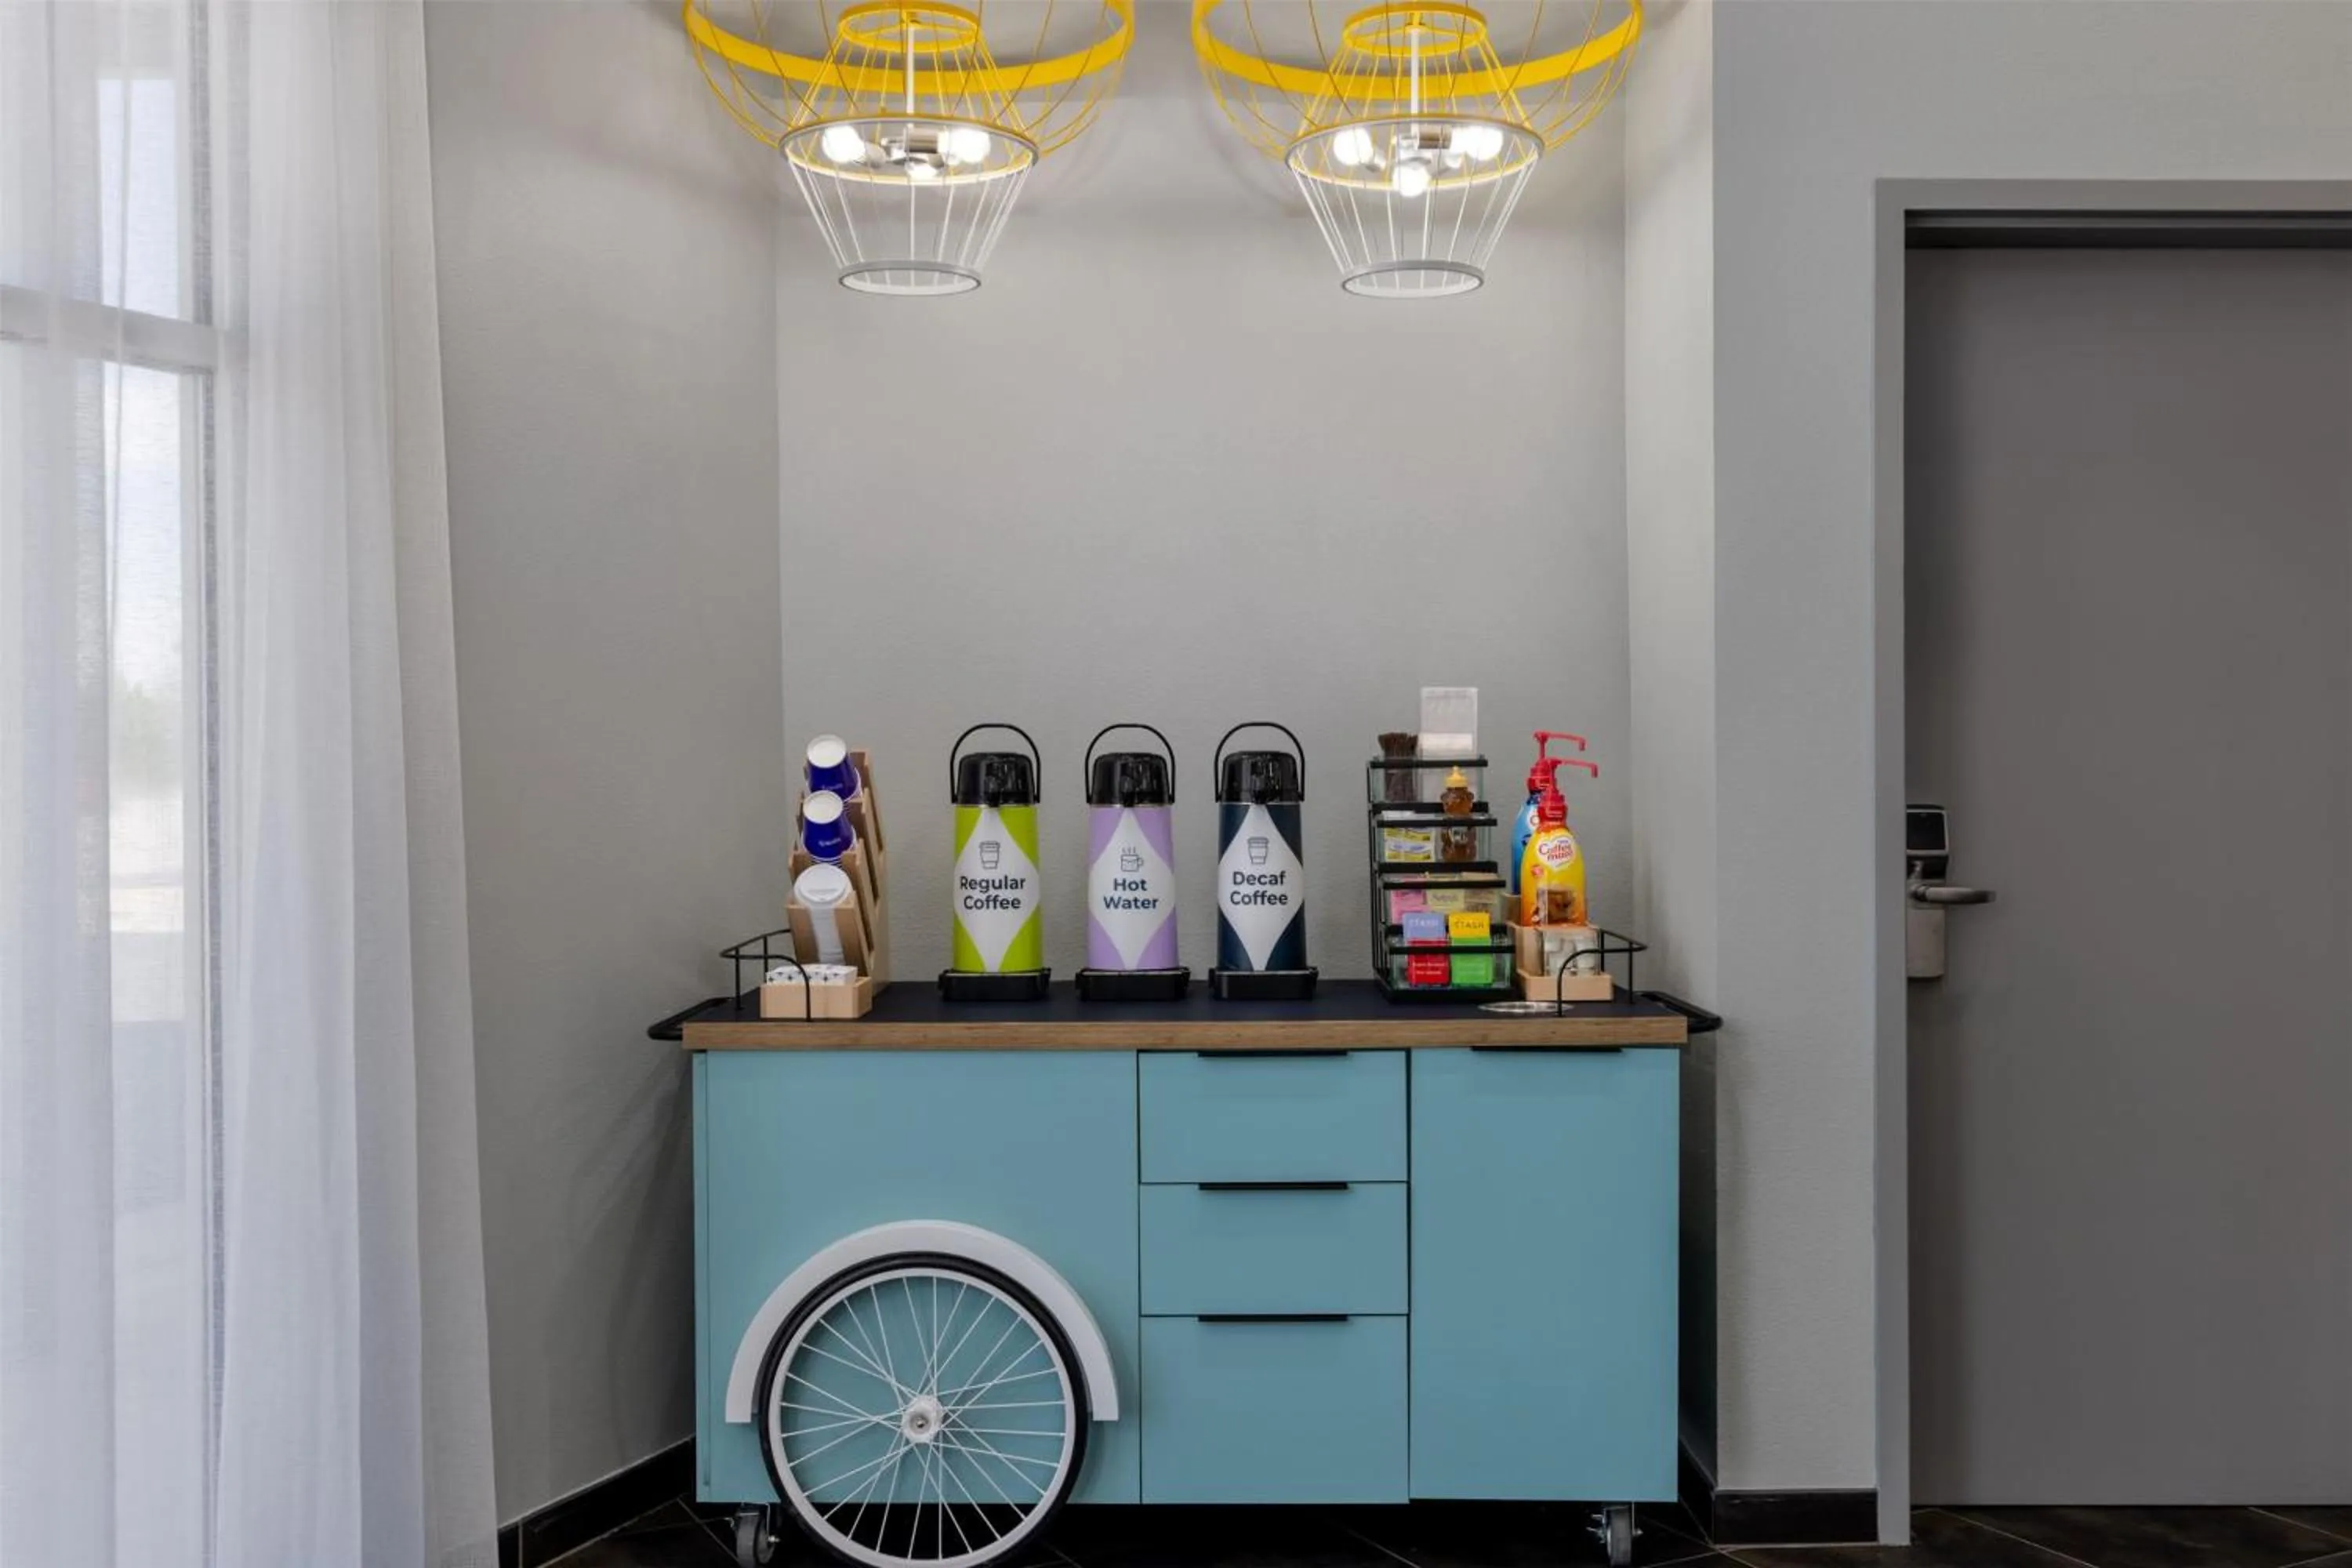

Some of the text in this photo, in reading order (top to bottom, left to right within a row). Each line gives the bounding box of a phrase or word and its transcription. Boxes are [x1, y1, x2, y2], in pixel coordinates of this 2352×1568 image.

[960, 874, 1026, 894] Regular
[1113, 877, 1148, 891] Hot
[1232, 869, 1287, 886] Decaf
[964, 895, 1022, 910] Coffee
[1103, 896, 1159, 909] Water
[1230, 890, 1288, 906] Coffee
